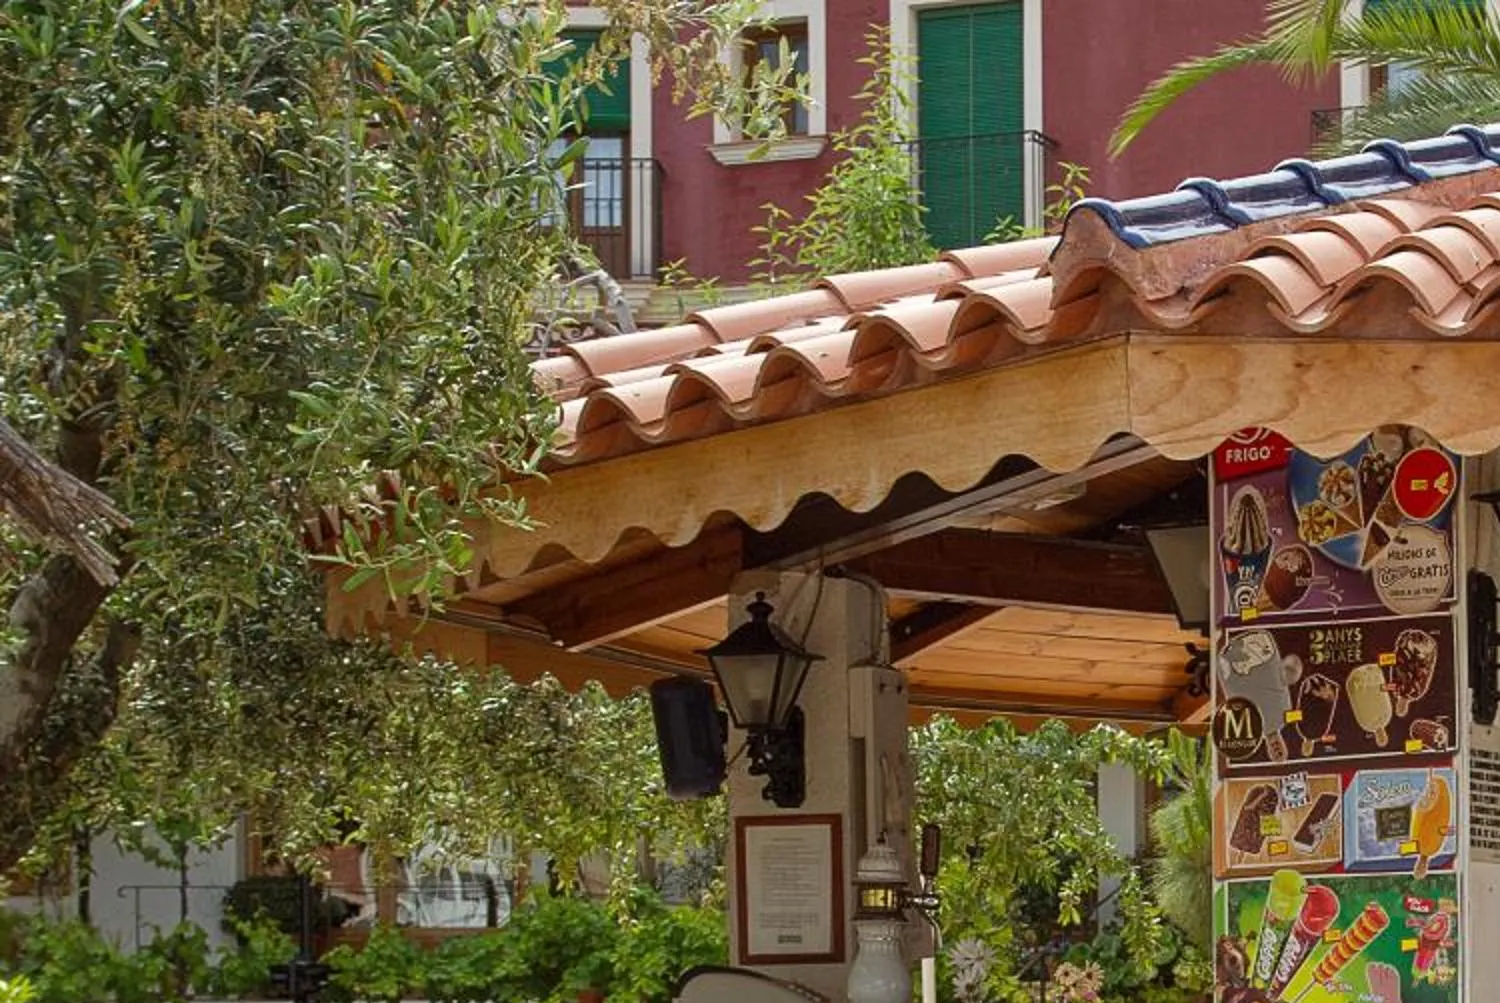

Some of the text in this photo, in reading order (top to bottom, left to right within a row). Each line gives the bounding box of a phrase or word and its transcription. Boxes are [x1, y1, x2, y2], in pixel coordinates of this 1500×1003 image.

[1225, 446, 1271, 464] FRIGO
[1409, 563, 1449, 579] GRATIS
[1325, 627, 1362, 643] ANYS
